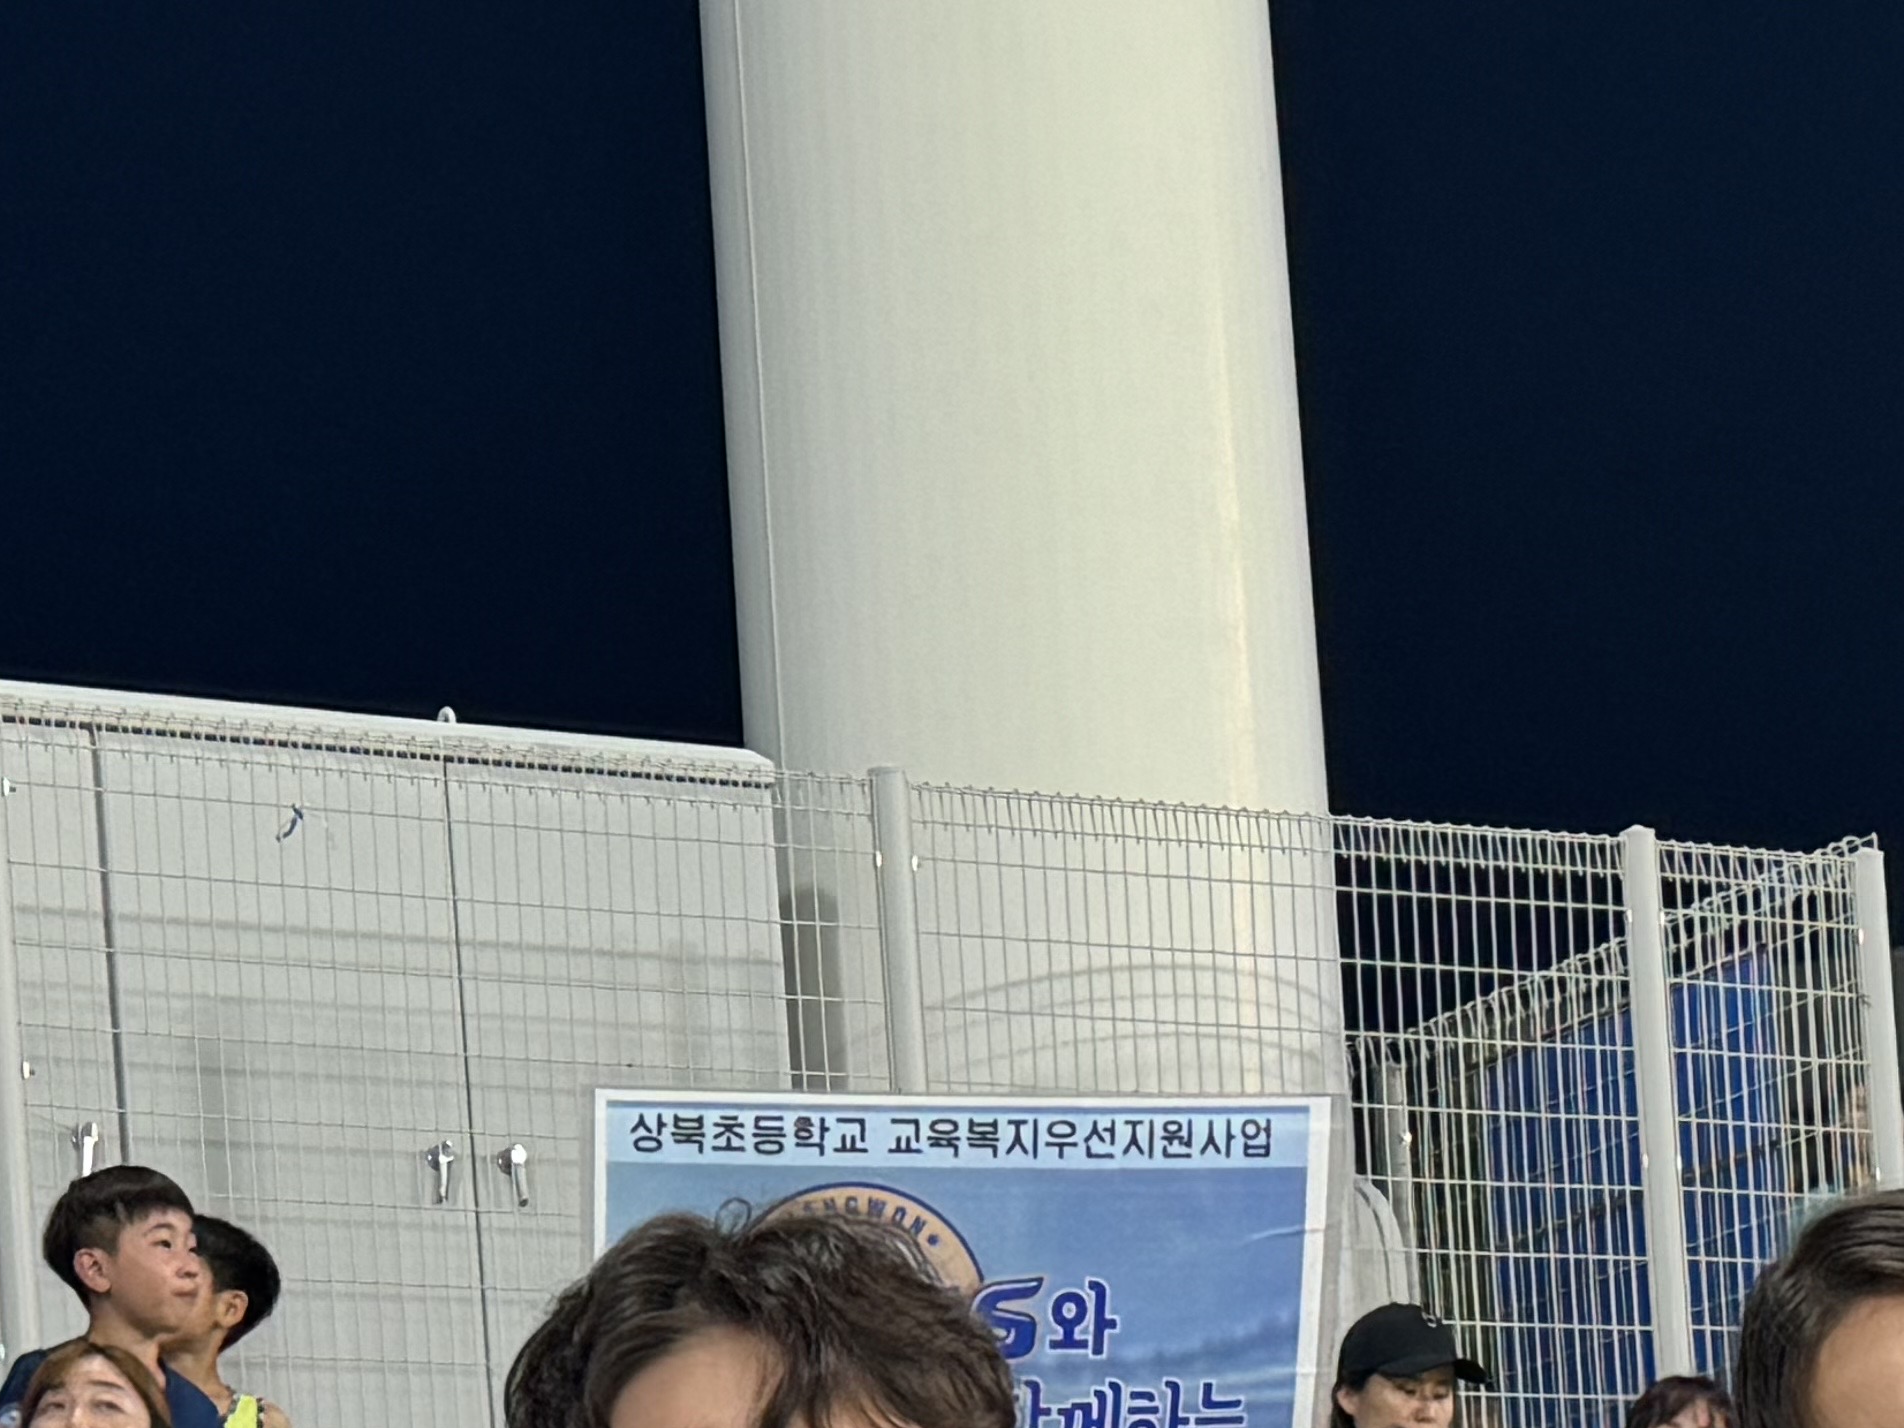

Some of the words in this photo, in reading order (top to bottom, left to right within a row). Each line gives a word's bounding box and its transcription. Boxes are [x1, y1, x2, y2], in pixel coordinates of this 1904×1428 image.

[629, 1110, 870, 1158] 상북초등학교
[887, 1113, 1274, 1162] 교육복지우선지원사업
[802, 1195, 928, 1237] NGWON
[1046, 1278, 1118, 1361] 와
